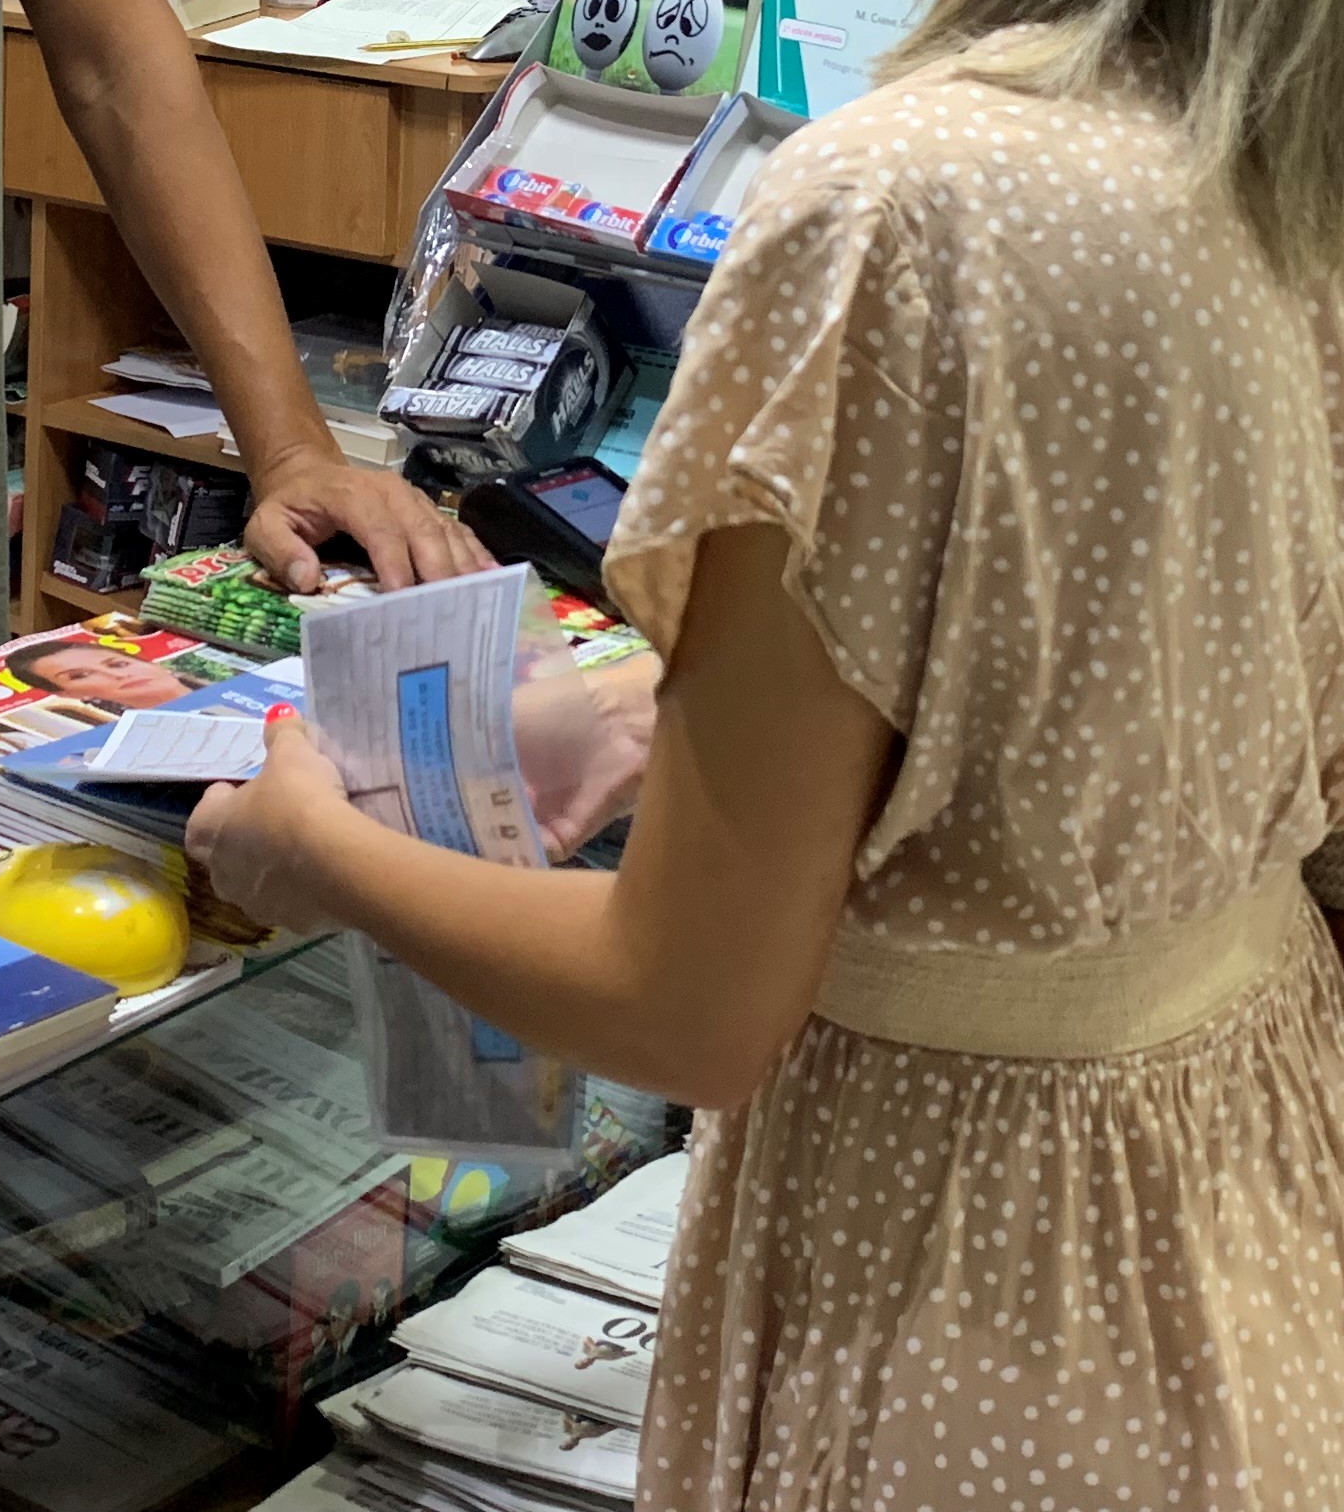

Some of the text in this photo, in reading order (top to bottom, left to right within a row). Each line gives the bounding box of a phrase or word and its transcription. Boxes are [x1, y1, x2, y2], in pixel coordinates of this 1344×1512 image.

[498, 169, 553, 197] Orbit
[577, 201, 633, 234] Orbit
[470, 329, 547, 354] HALLS
[513, 323, 565, 340] HALLS
[456, 358, 535, 383] HALLS
[407, 393, 487, 416] HALLS
[552, 351, 596, 441] HALLS
